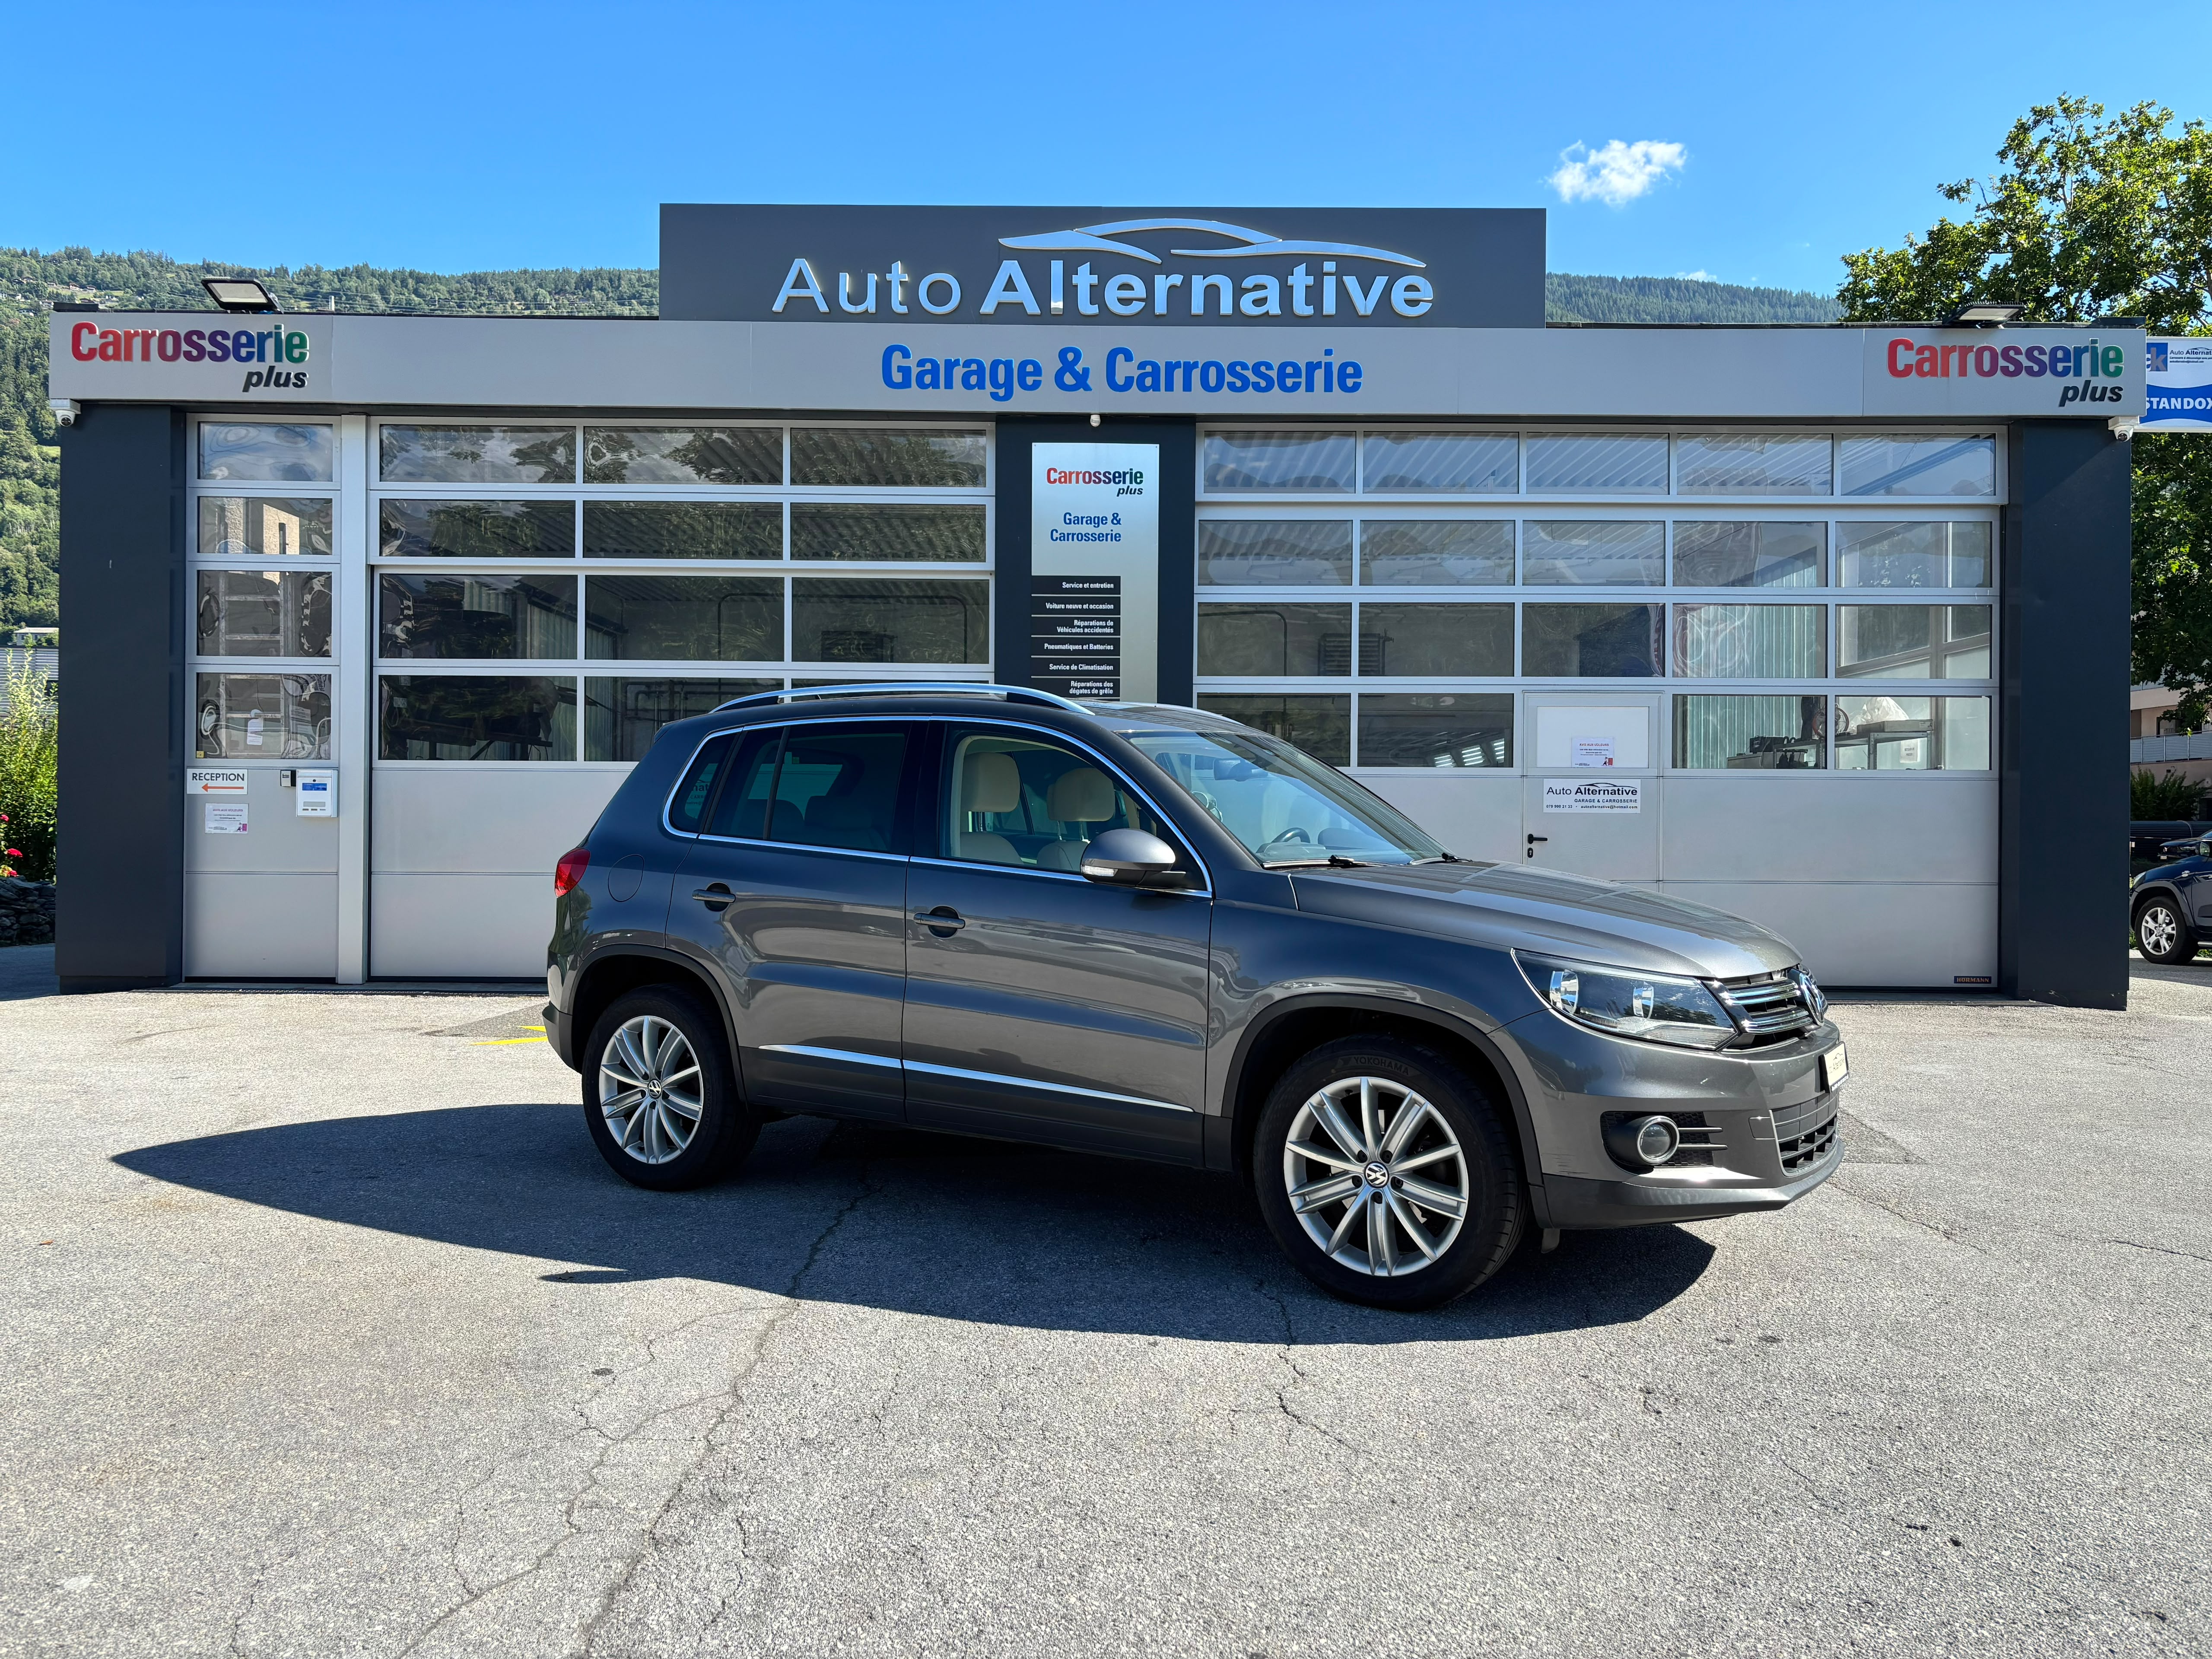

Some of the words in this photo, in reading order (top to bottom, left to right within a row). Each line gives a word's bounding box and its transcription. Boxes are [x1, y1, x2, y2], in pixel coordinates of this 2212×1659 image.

[772, 258, 961, 315] Auto
[980, 259, 1434, 316] Alternative
[71, 321, 309, 363] Carrosserie
[1887, 337, 2124, 378] Carrosserie
[242, 365, 309, 393] plus
[881, 344, 1042, 401] Garage
[1054, 345, 1093, 392] &
[1106, 347, 1363, 394] Carrosserie
[2058, 380, 2124, 407] plus
[1046, 467, 1144, 485] Carrosserie
[1116, 486, 1143, 497] plus
[1063, 512, 1108, 528] Garage
[1111, 512, 1122, 525] &
[1050, 529, 1122, 542] Carrosserie
[192, 773, 245, 781] RECEPTION
[1547, 787, 1572, 795] Auto
[1354, 1056, 1409, 1075] YOKOHAMA
